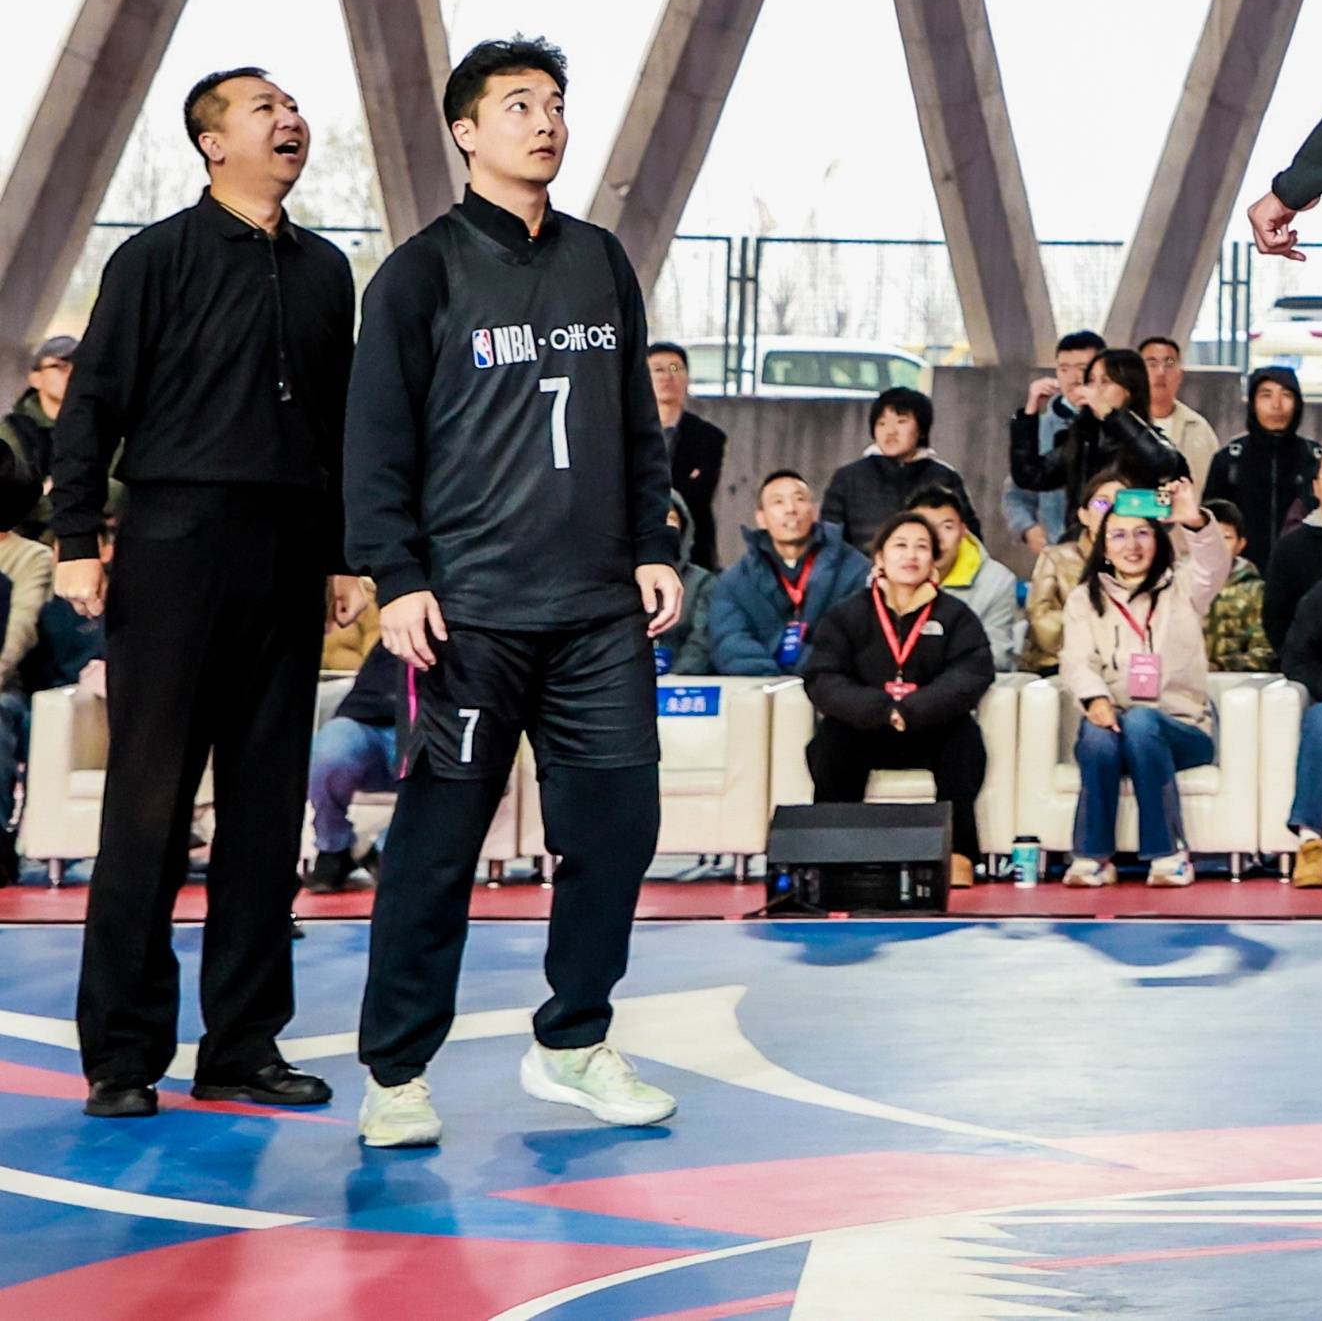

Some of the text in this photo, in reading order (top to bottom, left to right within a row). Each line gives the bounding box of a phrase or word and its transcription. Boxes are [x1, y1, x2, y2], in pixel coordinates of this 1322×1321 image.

[492, 322, 617, 366] NBA 咪咕
[538, 375, 571, 470] 7
[457, 707, 481, 764] 7
